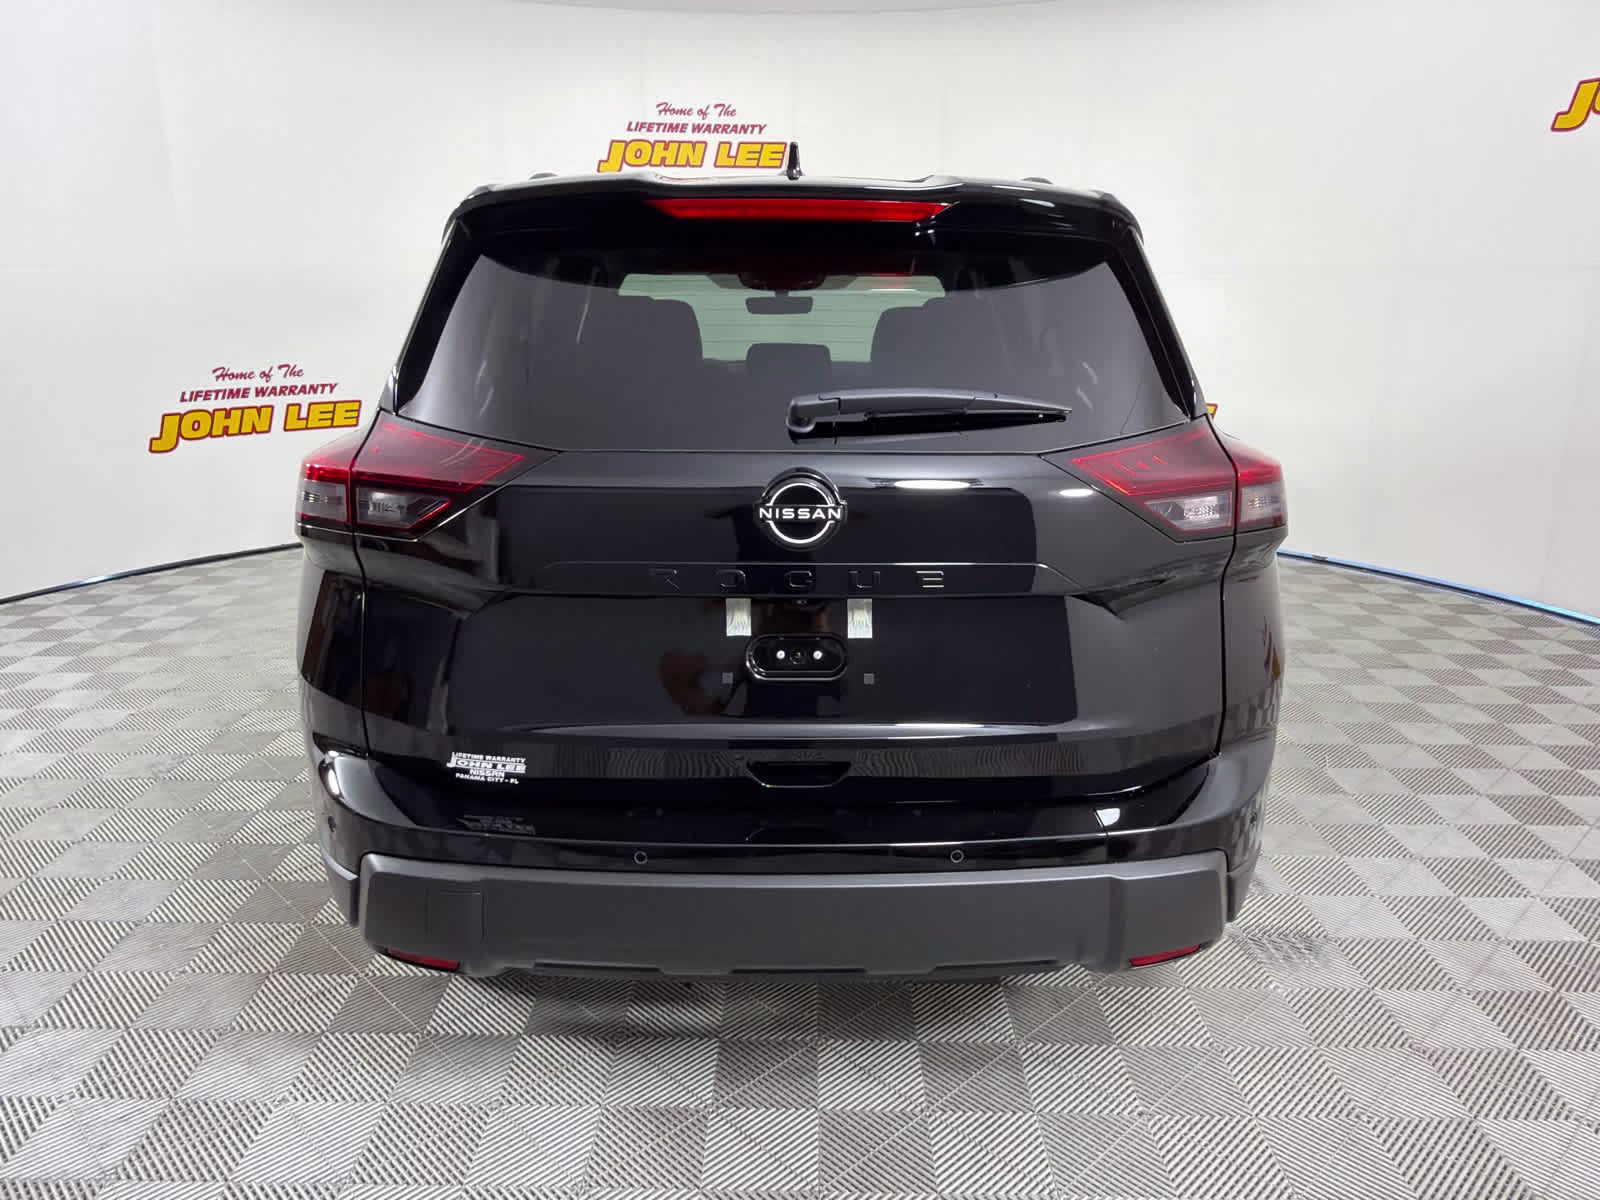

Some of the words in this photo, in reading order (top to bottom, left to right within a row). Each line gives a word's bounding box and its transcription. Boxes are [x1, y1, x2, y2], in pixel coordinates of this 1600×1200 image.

[656, 102, 693, 117] Home
[697, 104, 710, 120] of
[713, 103, 737, 117] The
[626, 121, 688, 133] LIFETIME
[691, 123, 767, 135] WARRANTY
[597, 139, 707, 173] JOHN
[714, 141, 787, 168] LEE
[212, 366, 255, 382] Home
[259, 366, 273, 382] of
[278, 363, 304, 379] The
[179, 387, 249, 402] LIFETIME
[255, 383, 338, 398] WARRANTY
[149, 405, 274, 453] JOHN
[283, 400, 362, 431] LEE
[759, 507, 842, 520] NISSAN
[648, 568, 945, 591] ROGUE
[446, 752, 493, 769] JOHN
[496, 763, 526, 772] LEE
[485, 755, 526, 763] WARRANTY
[455, 773, 485, 781] PANAMA
[470, 769, 505, 778] NISSAN
